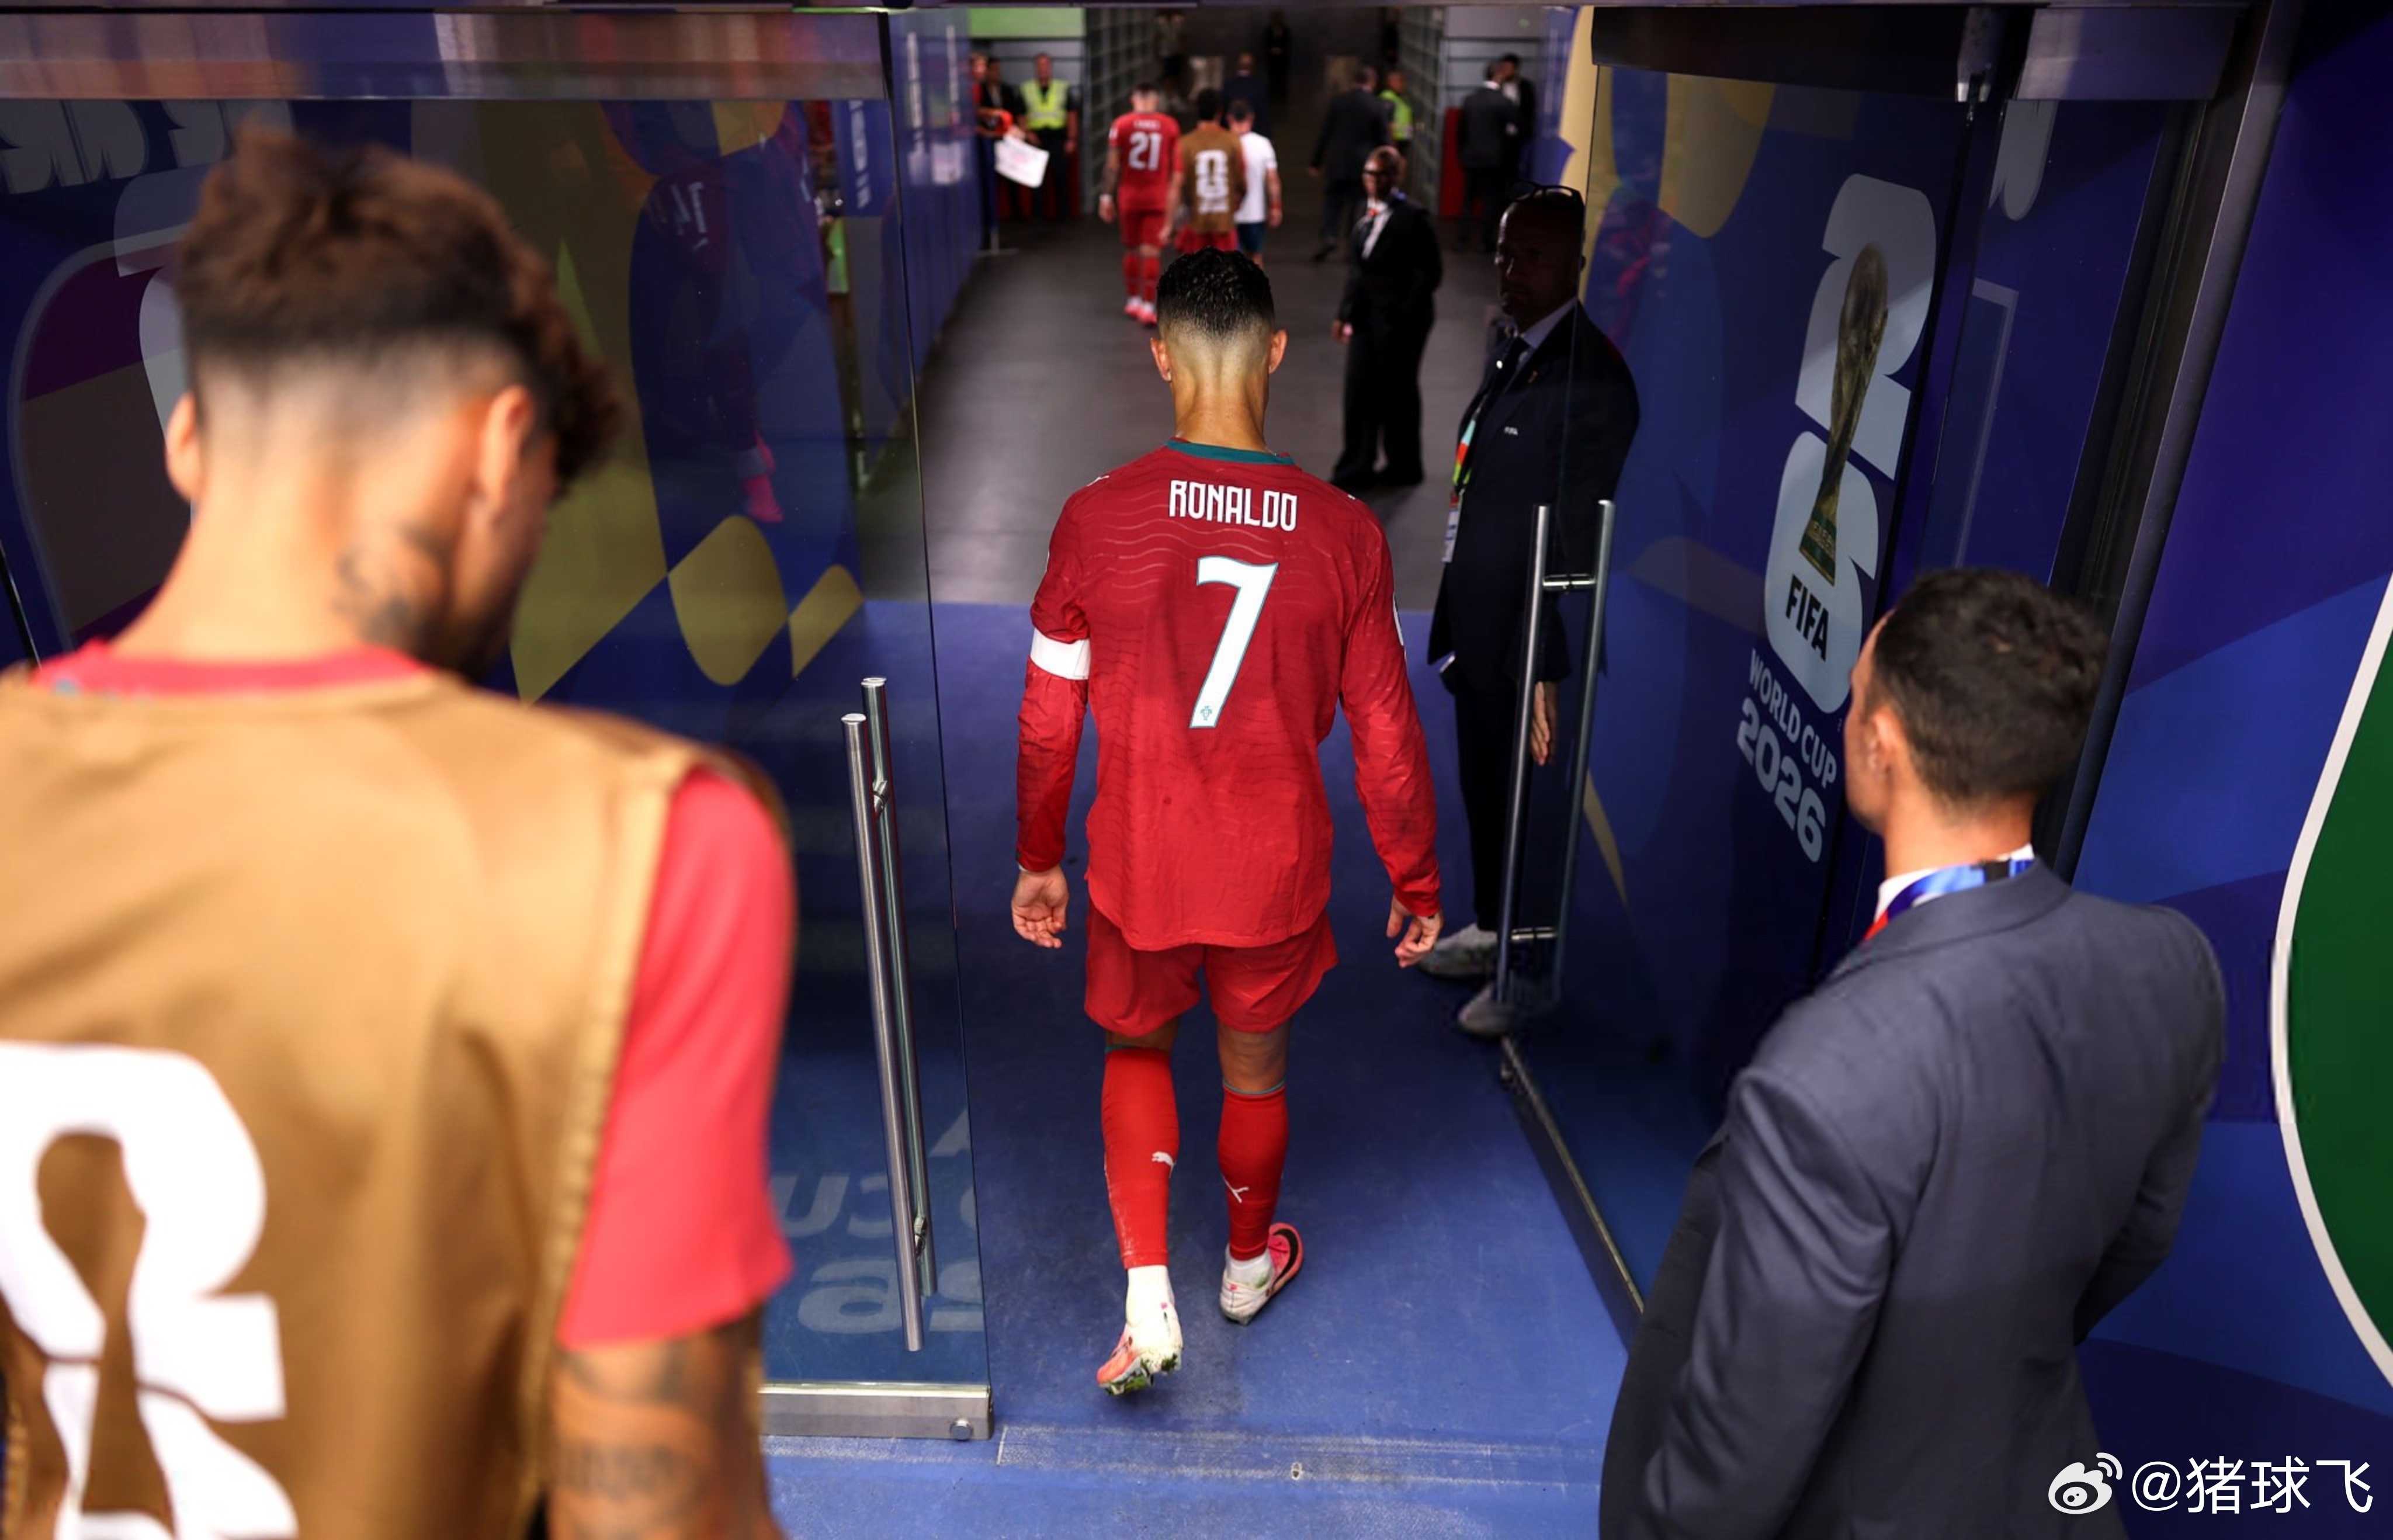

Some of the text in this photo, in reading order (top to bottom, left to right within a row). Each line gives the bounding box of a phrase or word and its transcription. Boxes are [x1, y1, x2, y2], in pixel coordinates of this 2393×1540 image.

[1128, 131, 1162, 171] 21
[1169, 480, 1298, 532] RONALDO
[1189, 555, 1279, 729] 7
[1785, 574, 1830, 661] FIFA
[1749, 648, 1837, 789] WORLD CUP
[1736, 698, 1826, 862] 2026
